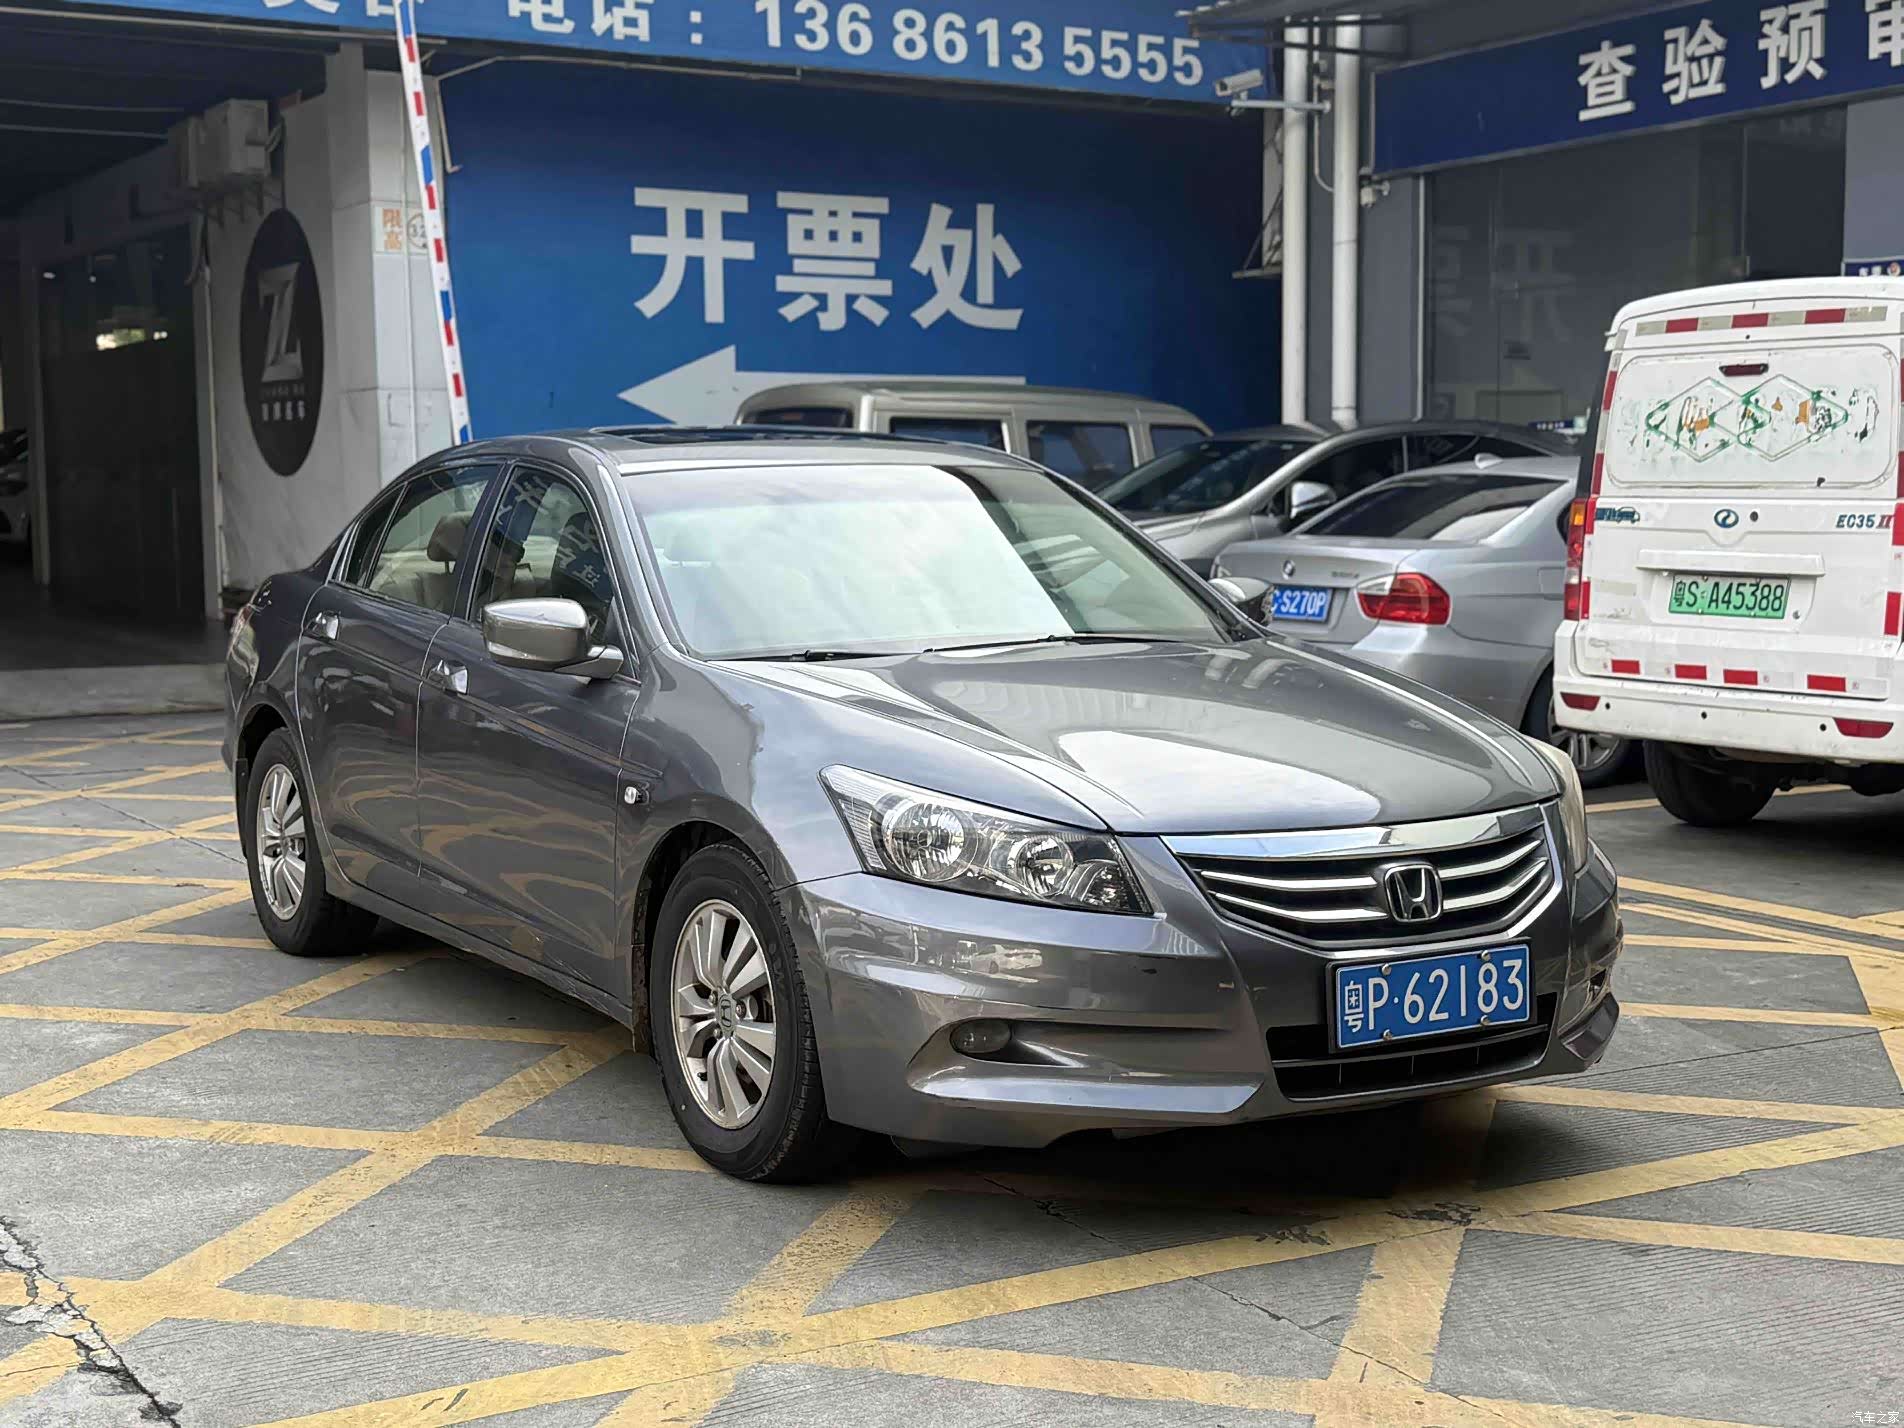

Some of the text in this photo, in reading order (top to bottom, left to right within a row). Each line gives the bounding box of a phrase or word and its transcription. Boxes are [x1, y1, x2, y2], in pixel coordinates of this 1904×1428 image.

[755, 0, 873, 56] 136
[892, 9, 1043, 71] 8613
[1063, 26, 1203, 86] 5555
[630, 186, 1025, 331] 开票处
